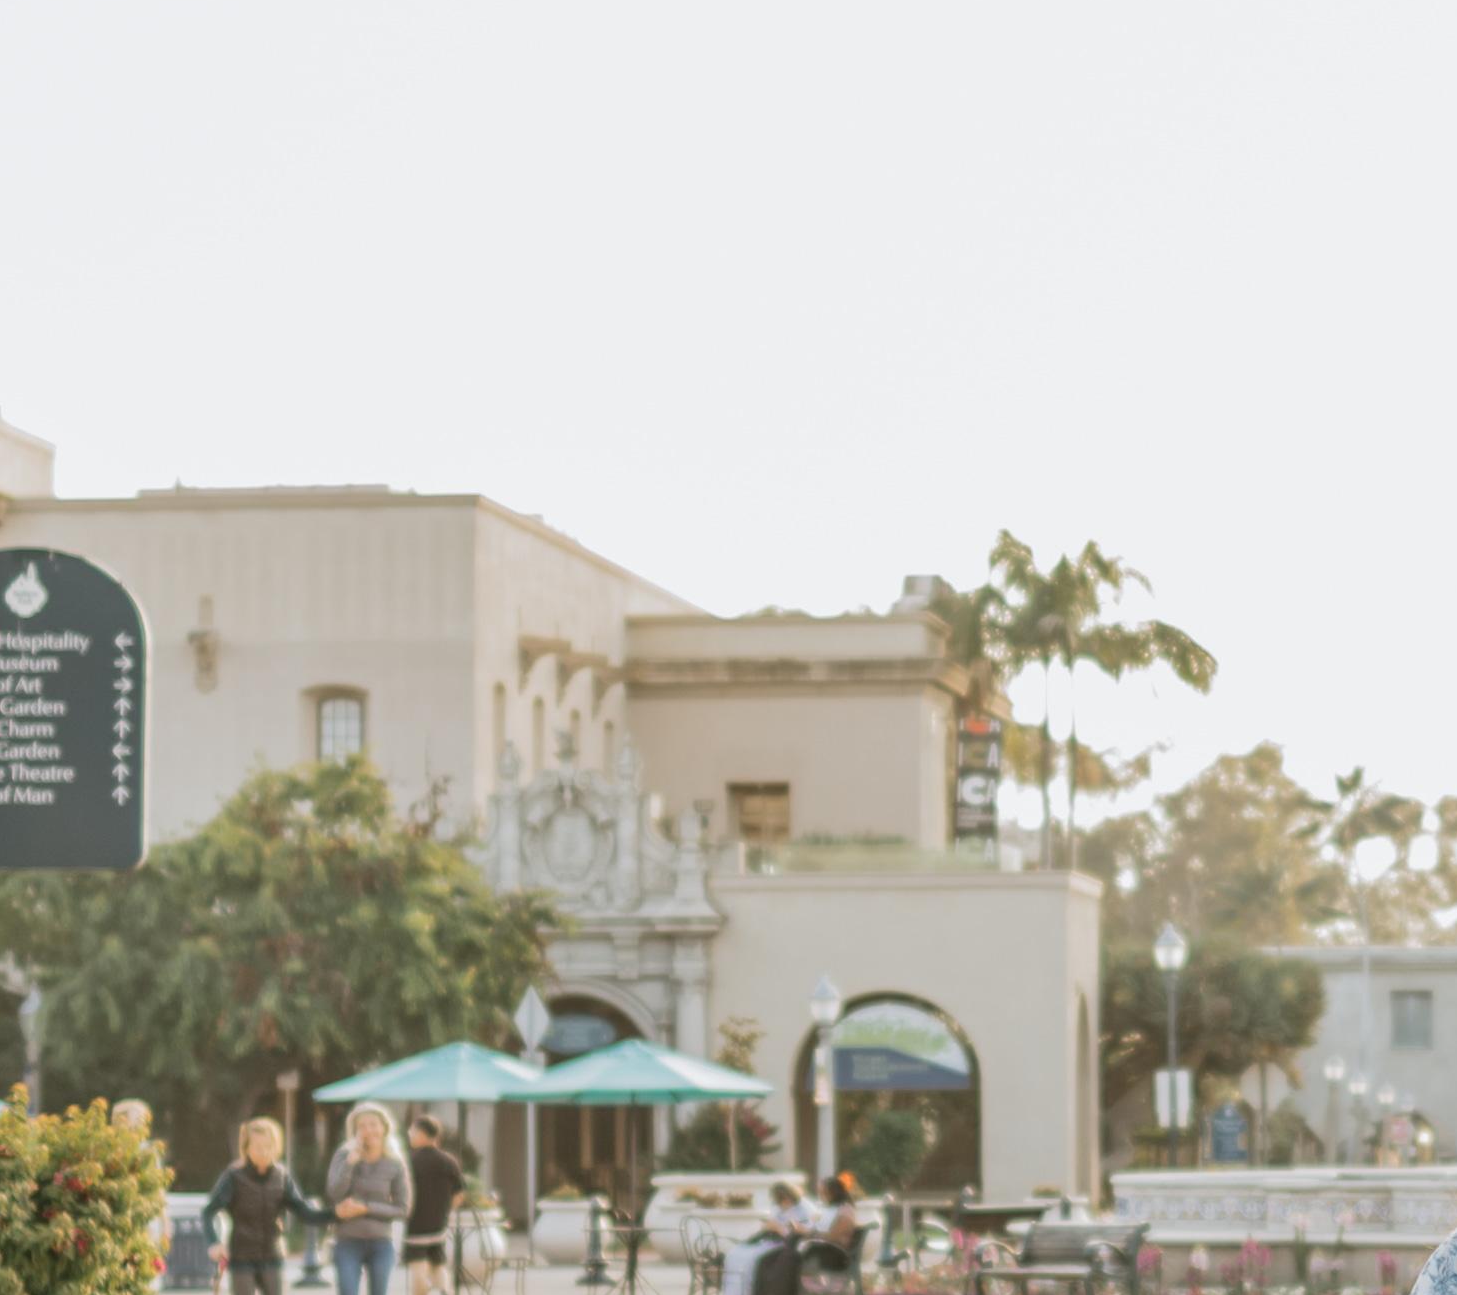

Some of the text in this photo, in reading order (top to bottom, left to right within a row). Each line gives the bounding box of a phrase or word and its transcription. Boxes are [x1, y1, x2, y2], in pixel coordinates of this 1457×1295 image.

[15, 676, 42, 693] Art
[0, 697, 65, 715] Garden
[9, 763, 76, 782] Theatre
[13, 786, 55, 803] Man
